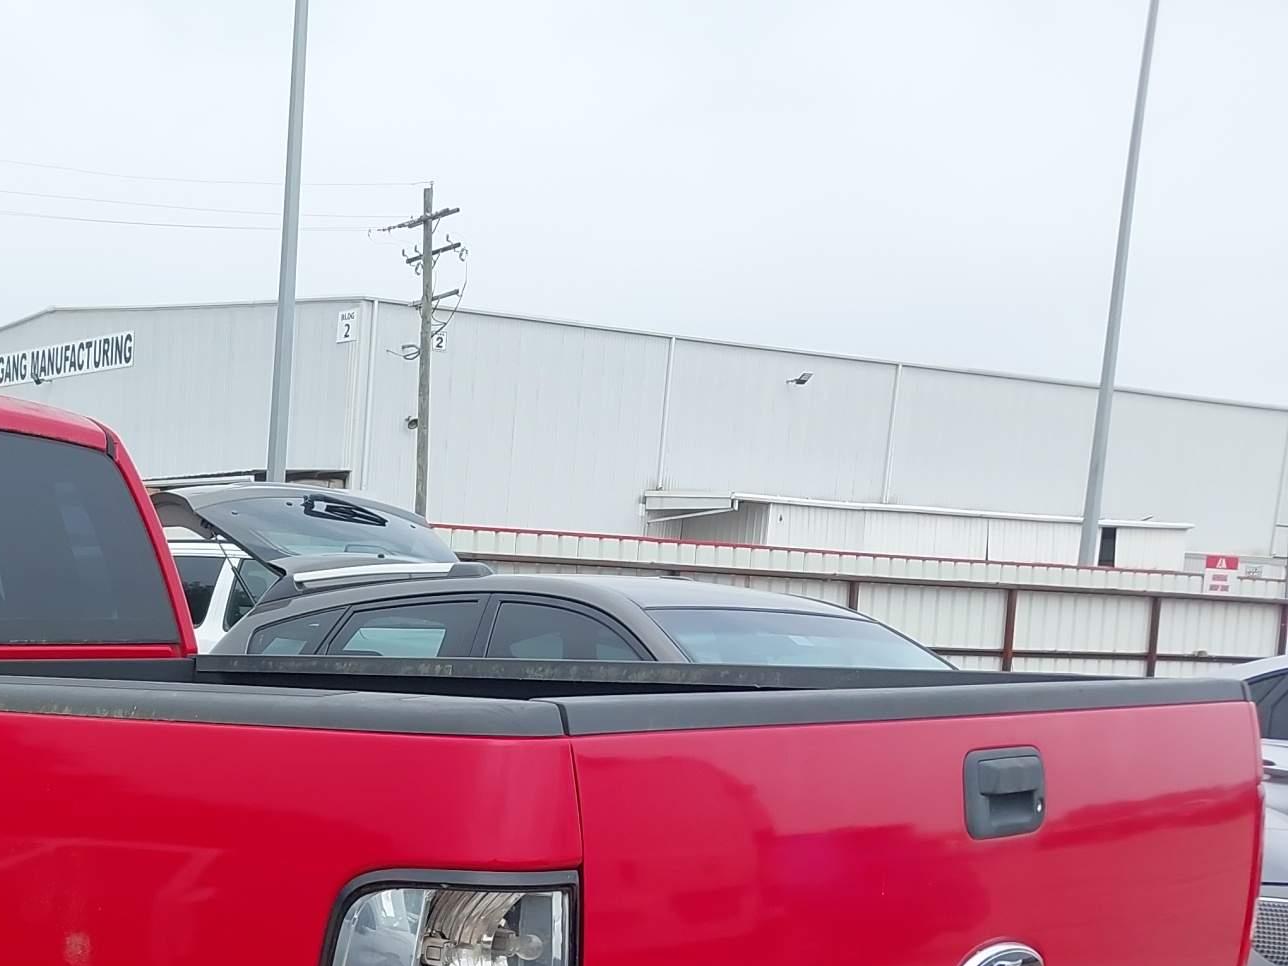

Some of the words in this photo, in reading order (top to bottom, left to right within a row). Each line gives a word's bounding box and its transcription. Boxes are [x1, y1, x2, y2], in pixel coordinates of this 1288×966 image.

[341, 312, 355, 320] BLDG
[344, 323, 351, 338] 2
[435, 336, 444, 349] 2
[30, 333, 133, 379] MANUFACTURING
